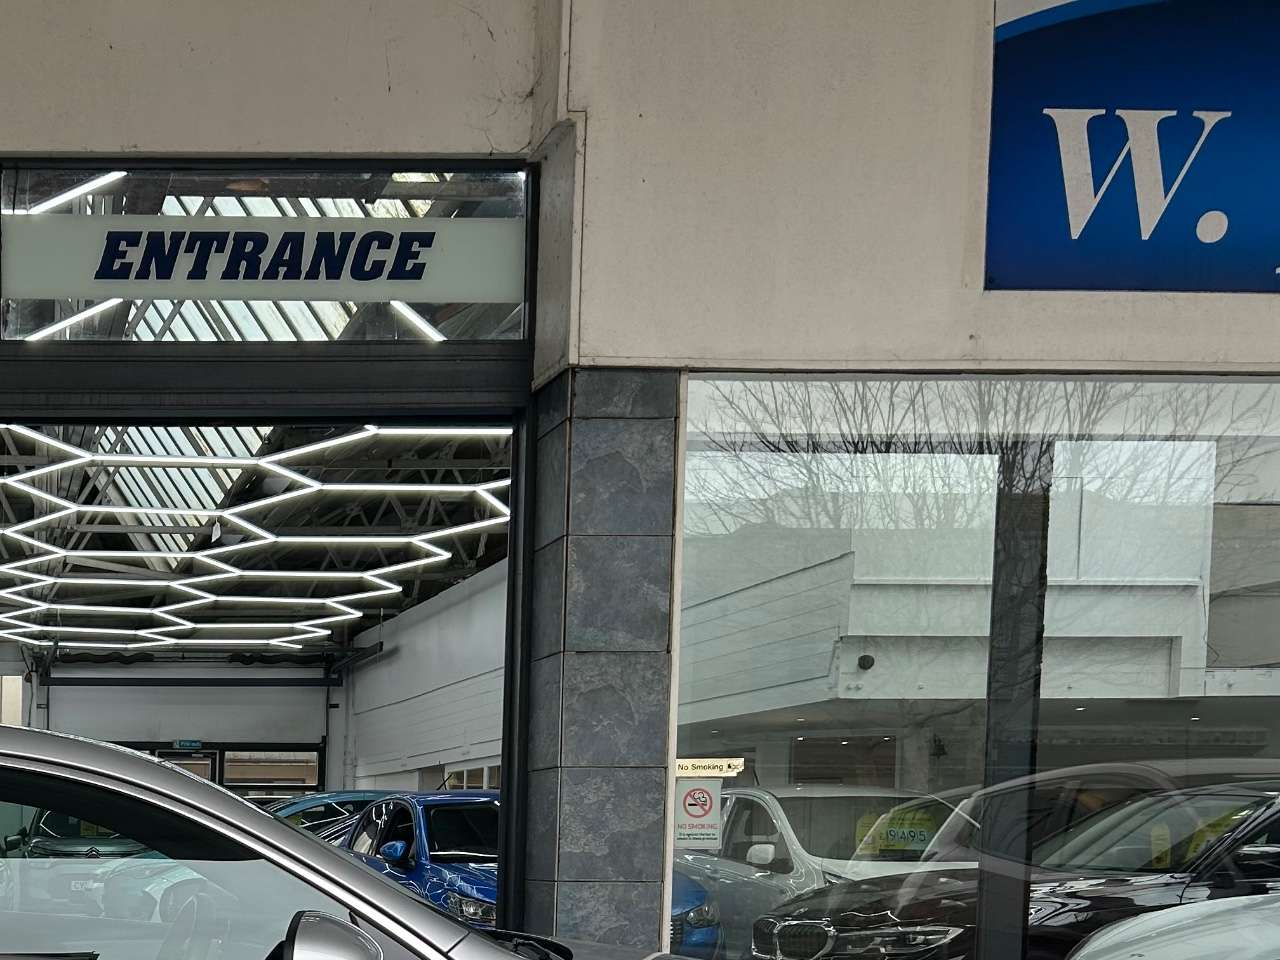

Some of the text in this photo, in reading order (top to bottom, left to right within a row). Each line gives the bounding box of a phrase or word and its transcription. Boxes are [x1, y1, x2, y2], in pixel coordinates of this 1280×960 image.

[1043, 108, 1232, 244] W.
[93, 230, 437, 282] ENTRANCE
[677, 763, 724, 772] No Smoking
